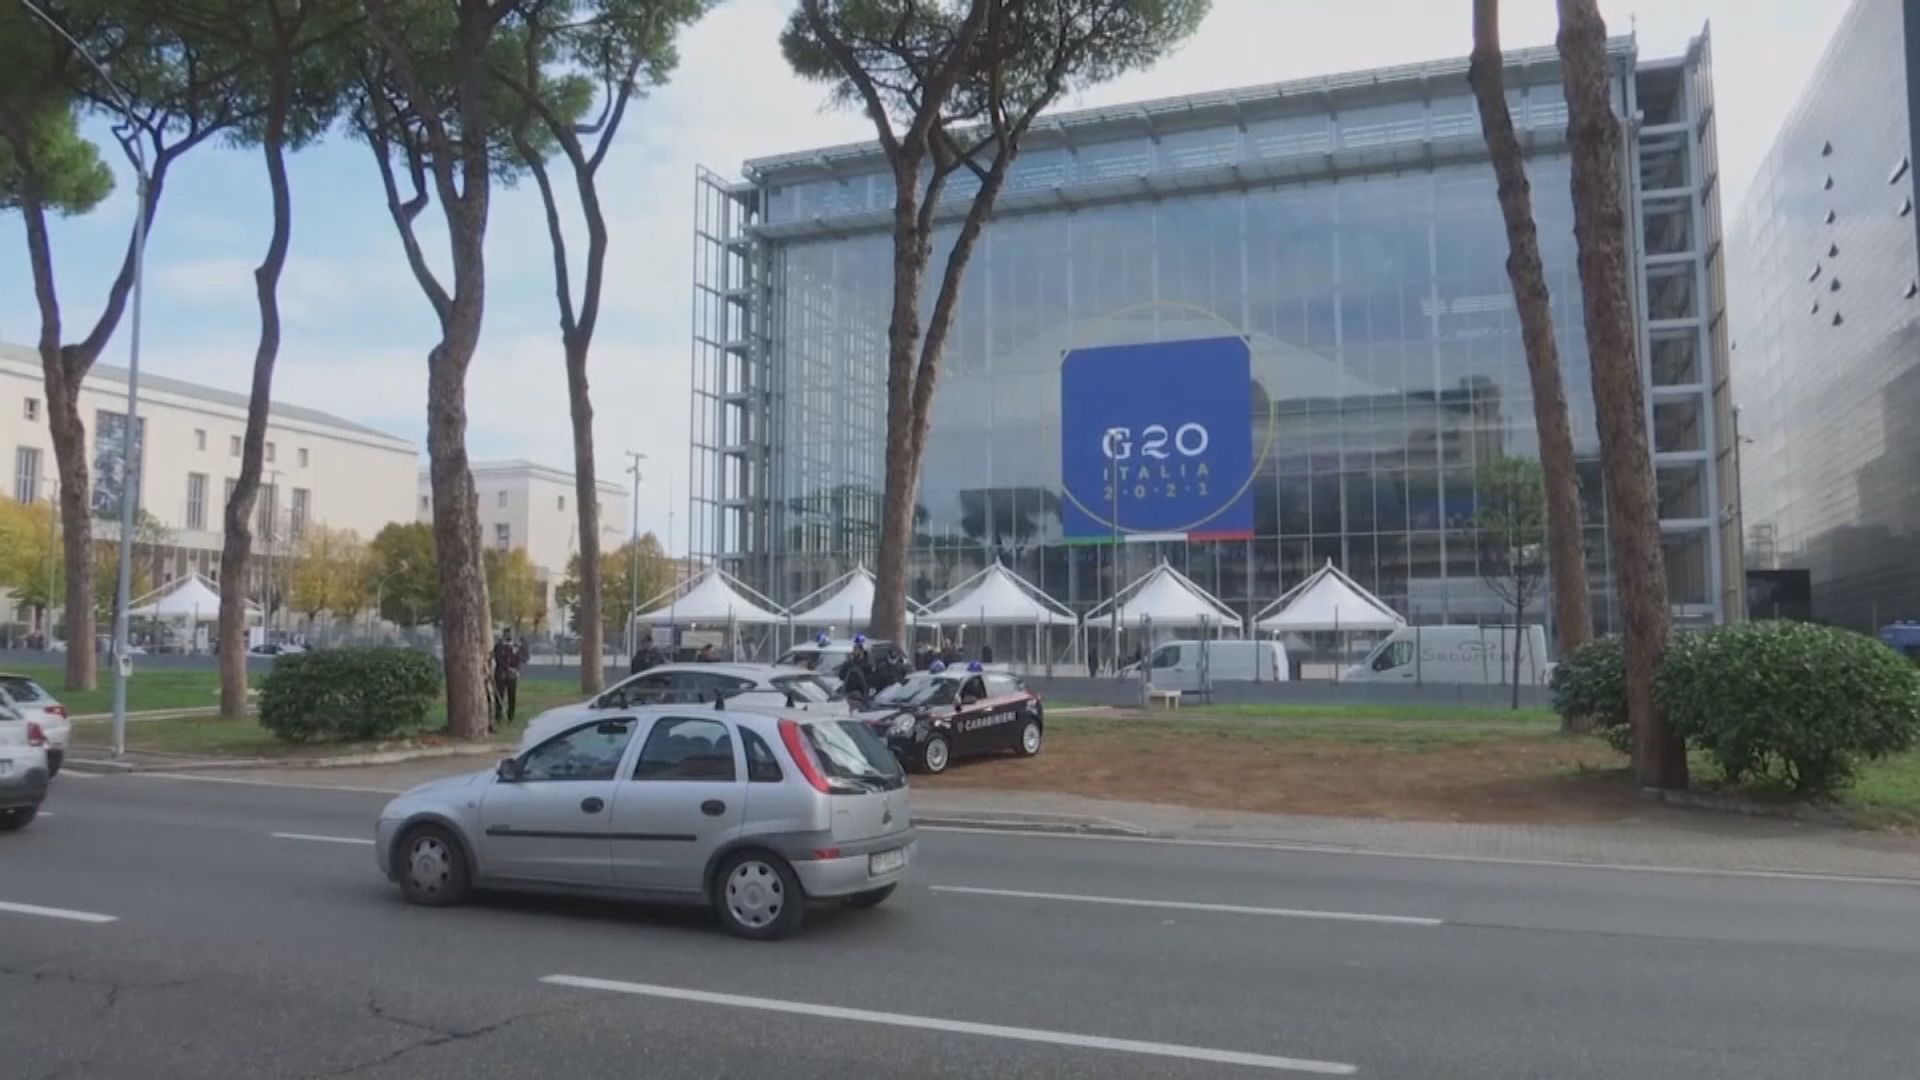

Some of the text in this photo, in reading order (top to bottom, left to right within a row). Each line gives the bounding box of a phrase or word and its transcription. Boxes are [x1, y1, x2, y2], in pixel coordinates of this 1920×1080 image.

[1102, 422, 1209, 460] G20
[1103, 463, 1209, 481] ITALIA
[965, 711, 1017, 731] CARABINIERI
